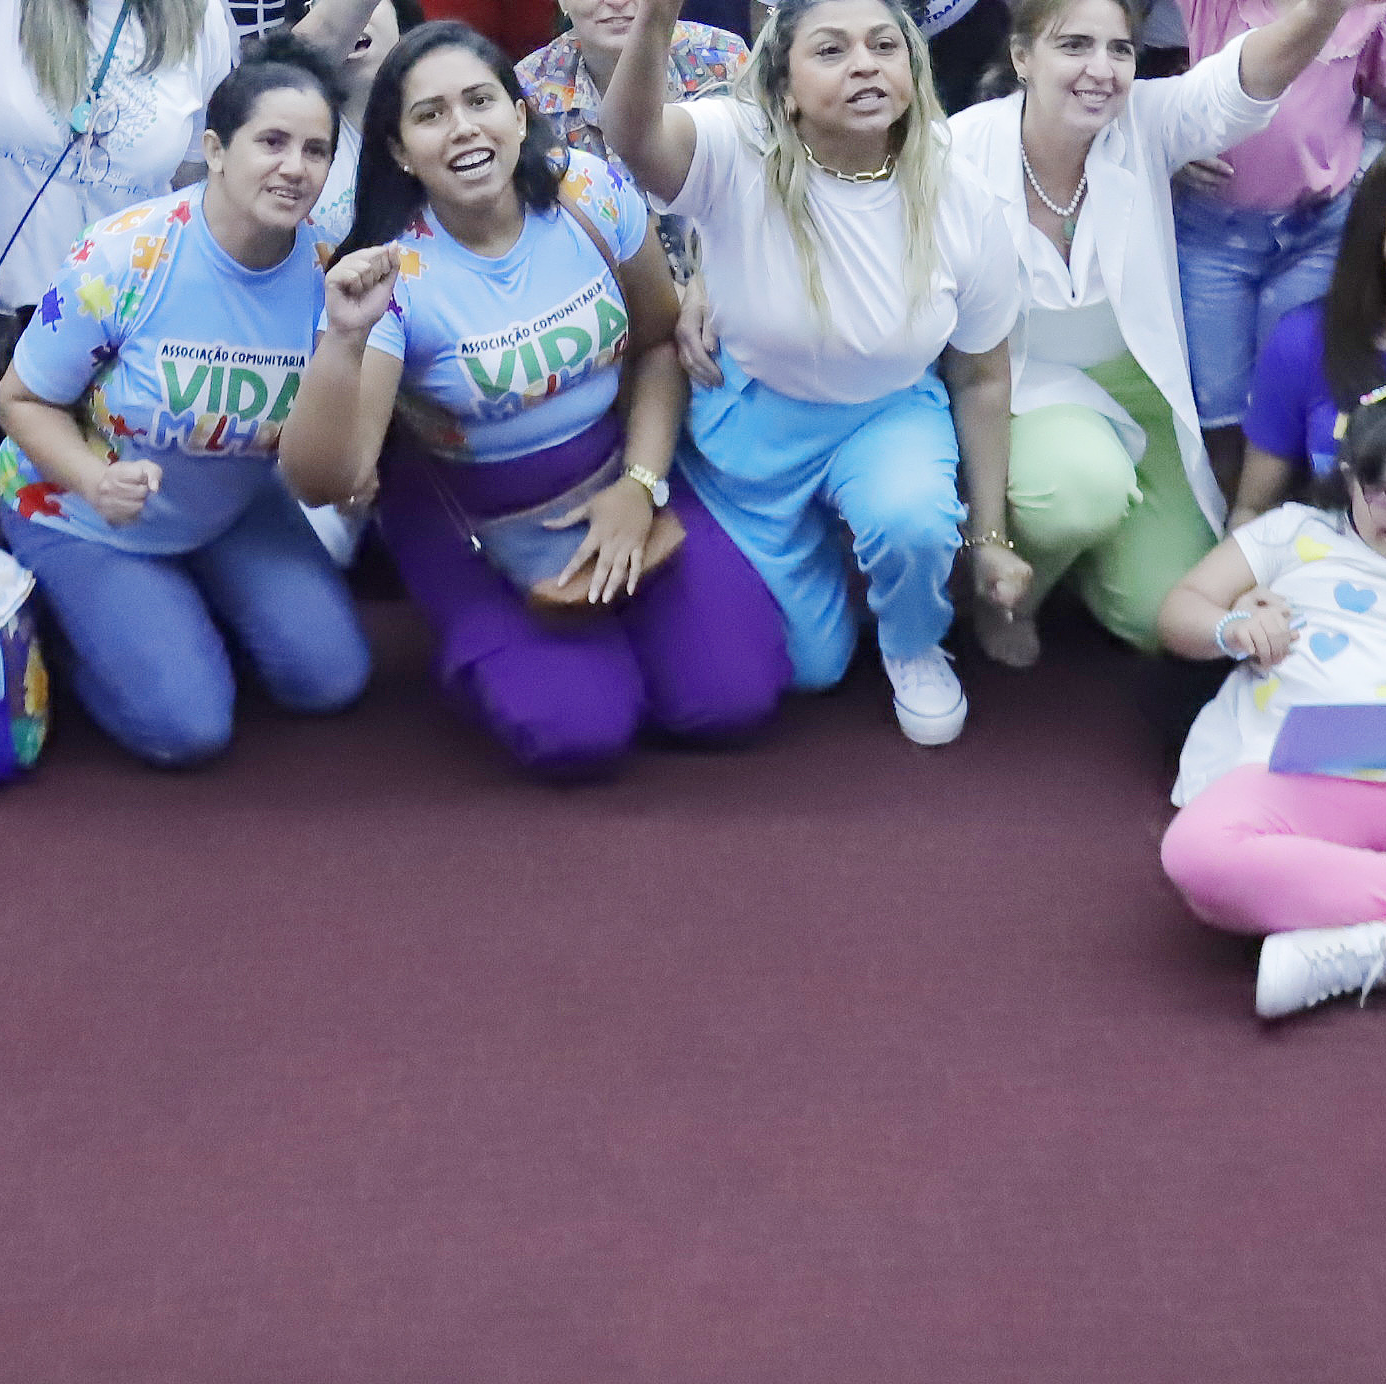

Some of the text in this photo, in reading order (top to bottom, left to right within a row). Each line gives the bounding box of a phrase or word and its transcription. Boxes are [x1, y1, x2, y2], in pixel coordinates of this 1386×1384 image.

[162, 344, 229, 365] ASSOCIAÇÃO
[461, 326, 530, 354] ASSOCIAÇÃO
[464, 297, 628, 402] VIDA
[162, 360, 301, 424] VIDA
[156, 410, 283, 452] MELHO
